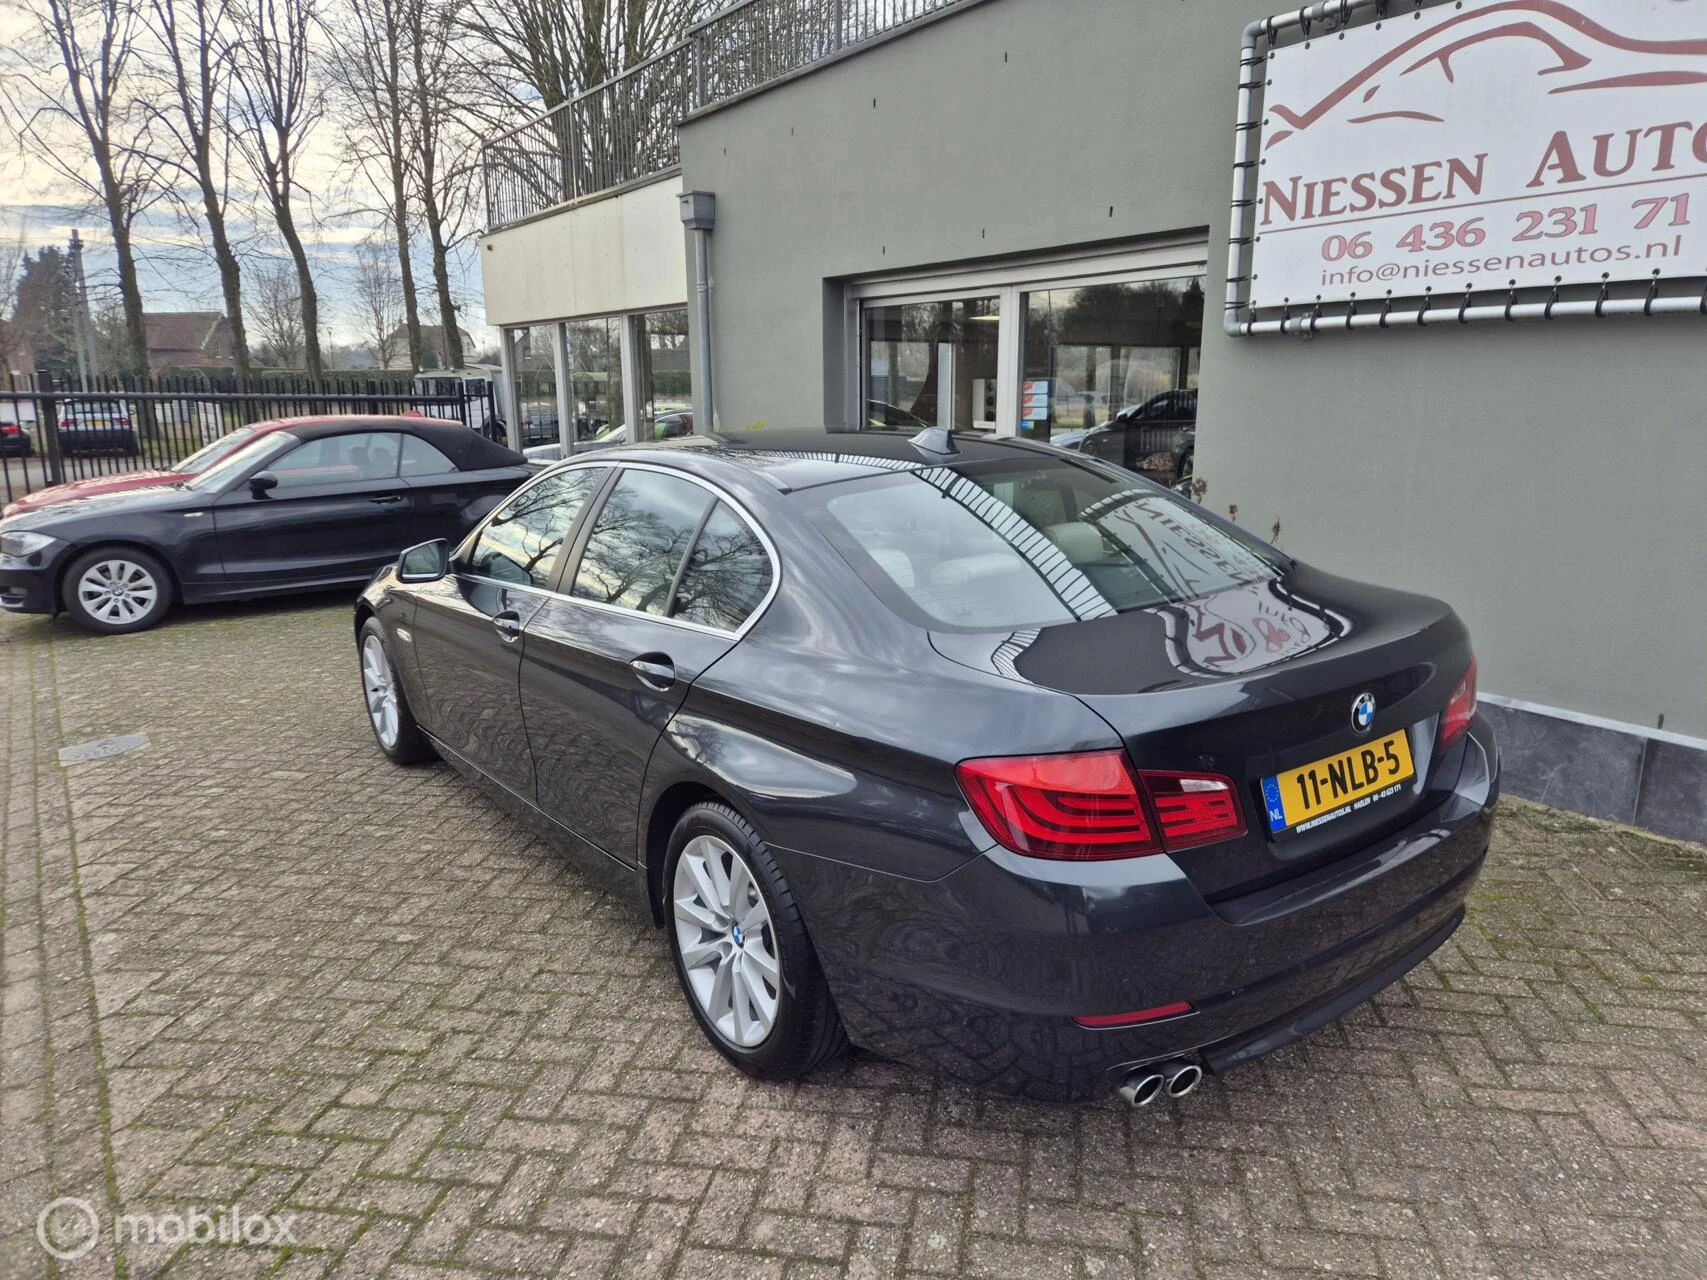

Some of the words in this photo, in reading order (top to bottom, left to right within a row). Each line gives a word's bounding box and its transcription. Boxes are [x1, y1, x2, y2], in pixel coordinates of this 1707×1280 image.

[1321, 232, 1373, 261] 06
[1397, 217, 1486, 253] 436
[1512, 203, 1599, 242] 231
[1631, 193, 1691, 229] 71
[1321, 235, 1683, 286] info@niessenautos.nl
[1297, 740, 1400, 809] 11-NLB-5
[1270, 808, 1283, 822] NL
